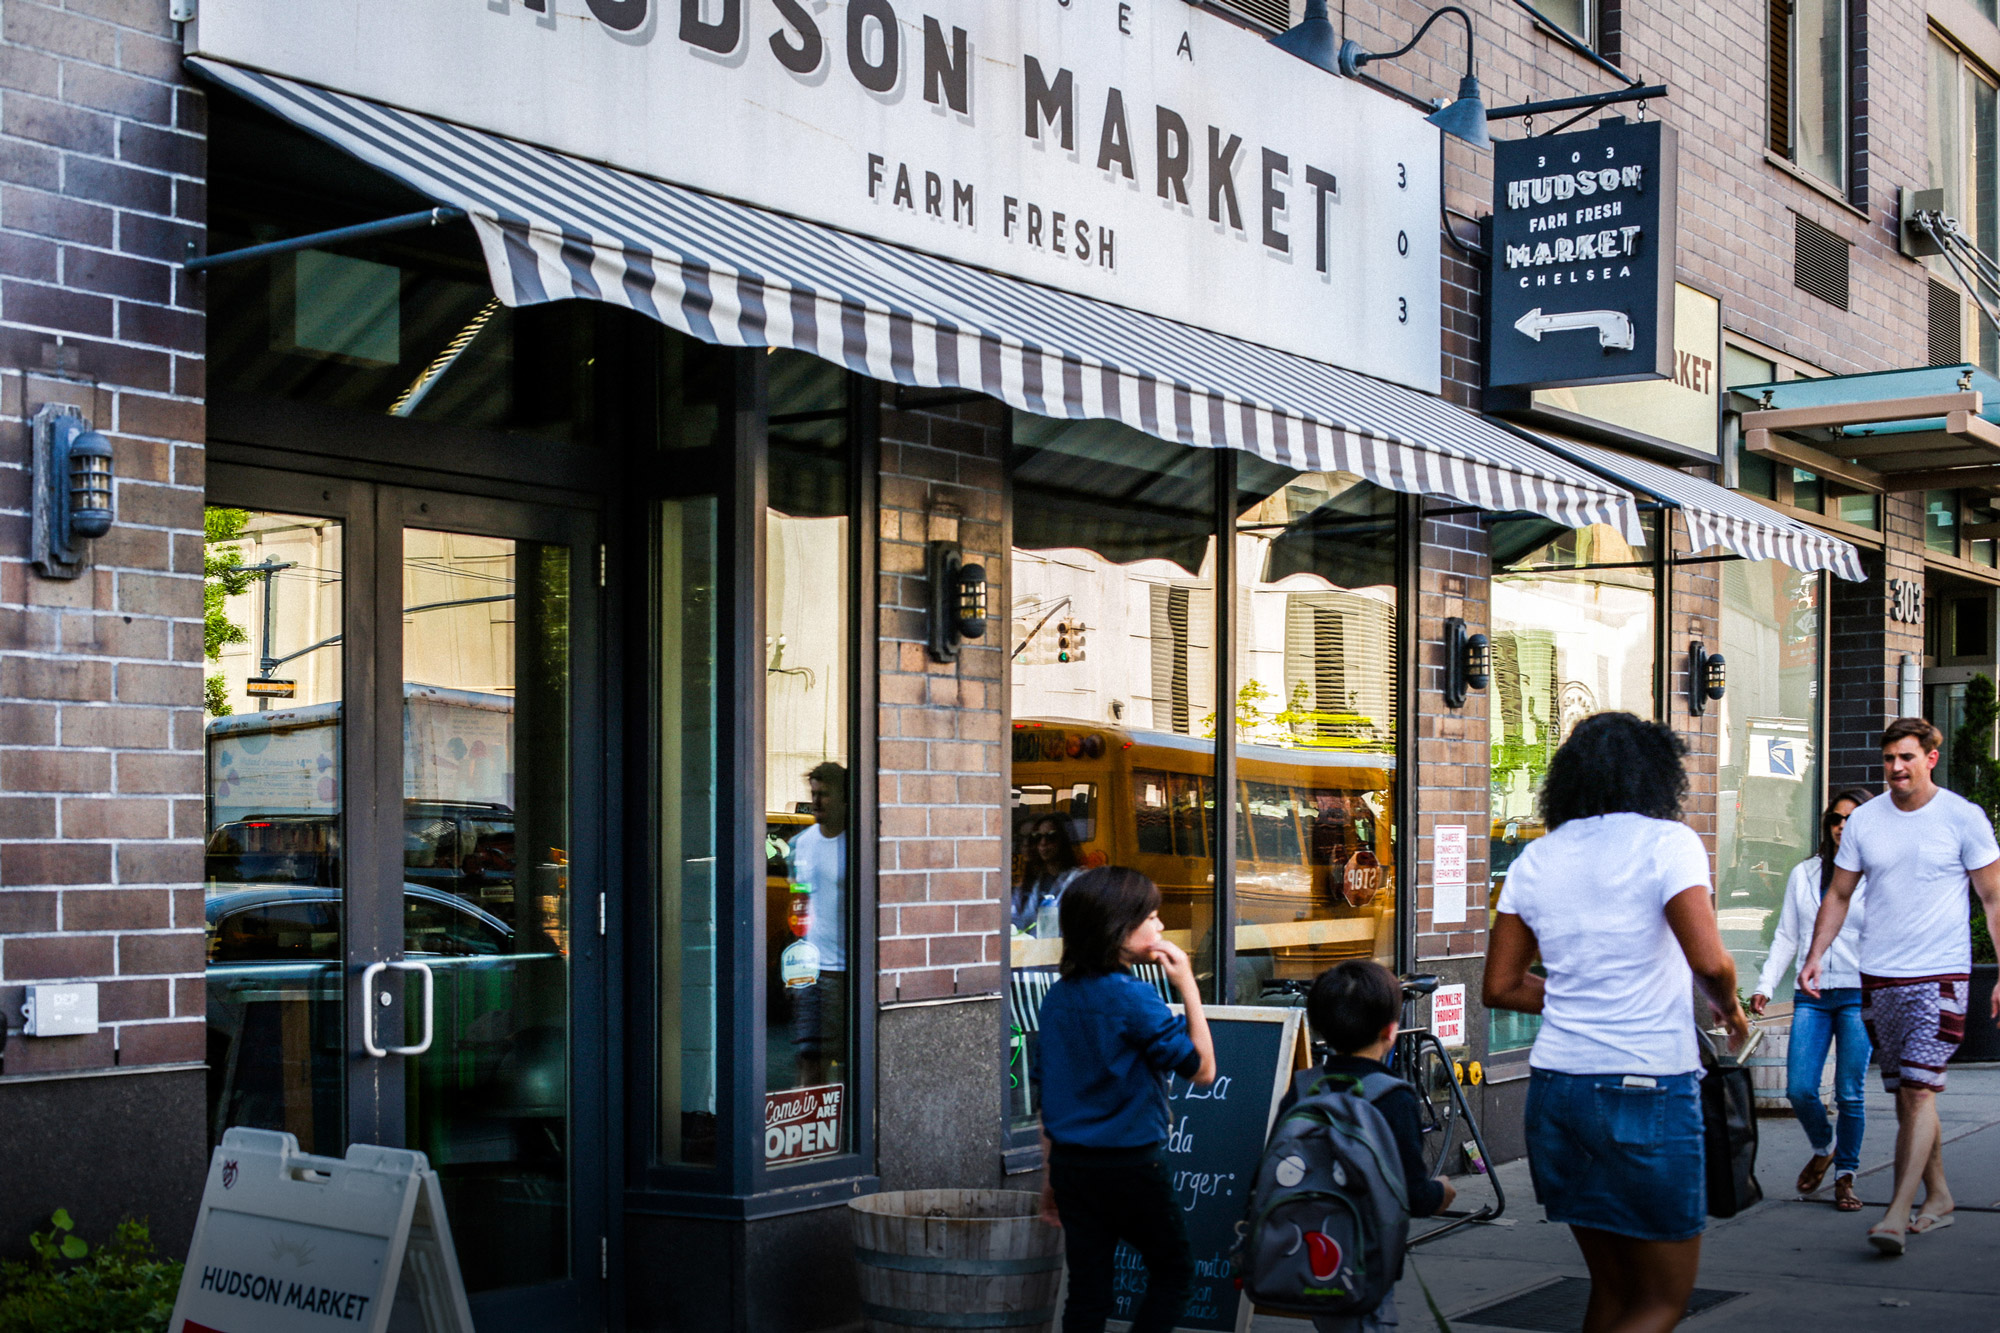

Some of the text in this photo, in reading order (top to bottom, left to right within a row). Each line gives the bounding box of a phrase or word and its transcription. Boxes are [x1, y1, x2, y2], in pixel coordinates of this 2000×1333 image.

[487, 0, 1339, 278] DSON MARKET
[1508, 165, 1642, 210] HUDSON
[867, 152, 1116, 273] FARM FRESH
[1529, 201, 1622, 233] FARM FRESH
[1506, 225, 1640, 269] MARKET
[1520, 265, 1631, 288] CHELSEA
[1891, 578, 1924, 625] 303
[1436, 845, 1465, 855] CONNECTION
[1440, 856, 1460, 867] FOR FIRE
[1436, 868, 1465, 879] DEPARTMENT
[1435, 993, 1462, 1007] SPRINKLERS
[1435, 1007, 1463, 1023] THROUGHOUT
[1438, 1023, 1459, 1038] BUILDING
[765, 1090, 841, 1124] Come in WE
[816, 1103, 838, 1119] ARE
[765, 1118, 837, 1159] OPEN
[200, 1265, 369, 1321] HUDSON MARKET
